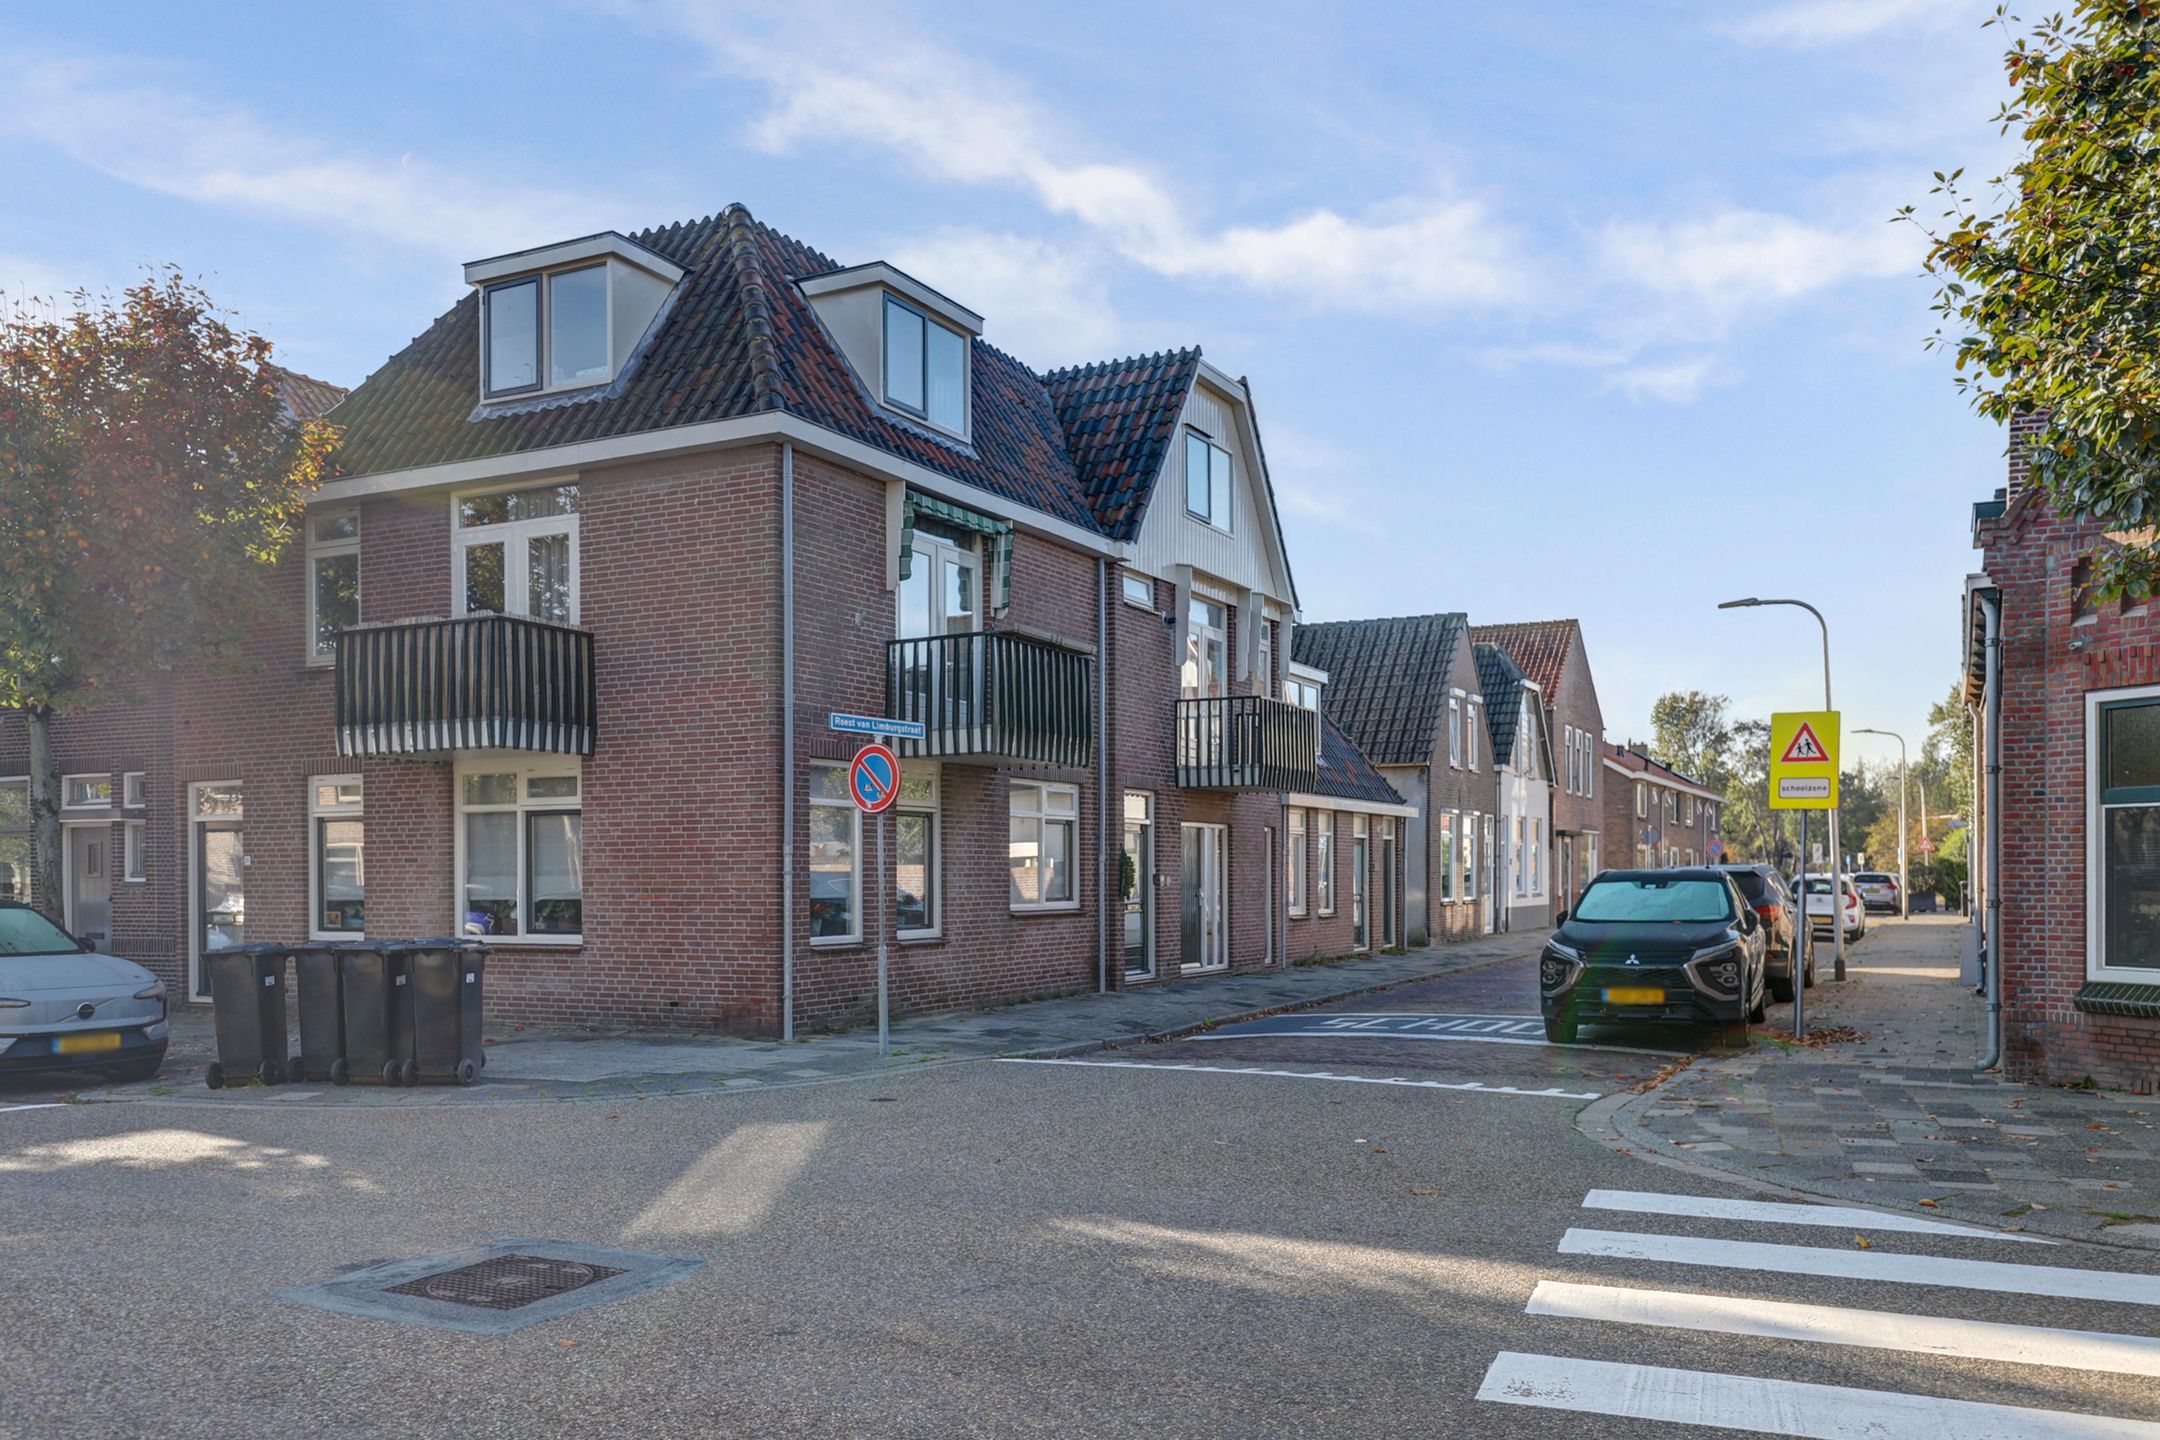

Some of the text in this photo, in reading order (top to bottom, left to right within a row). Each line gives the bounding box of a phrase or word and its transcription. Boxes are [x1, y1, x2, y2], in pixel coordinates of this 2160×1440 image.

[834, 716, 921, 735] Roest van Limburgstraat
[1303, 1017, 1547, 1035] SCHOO
